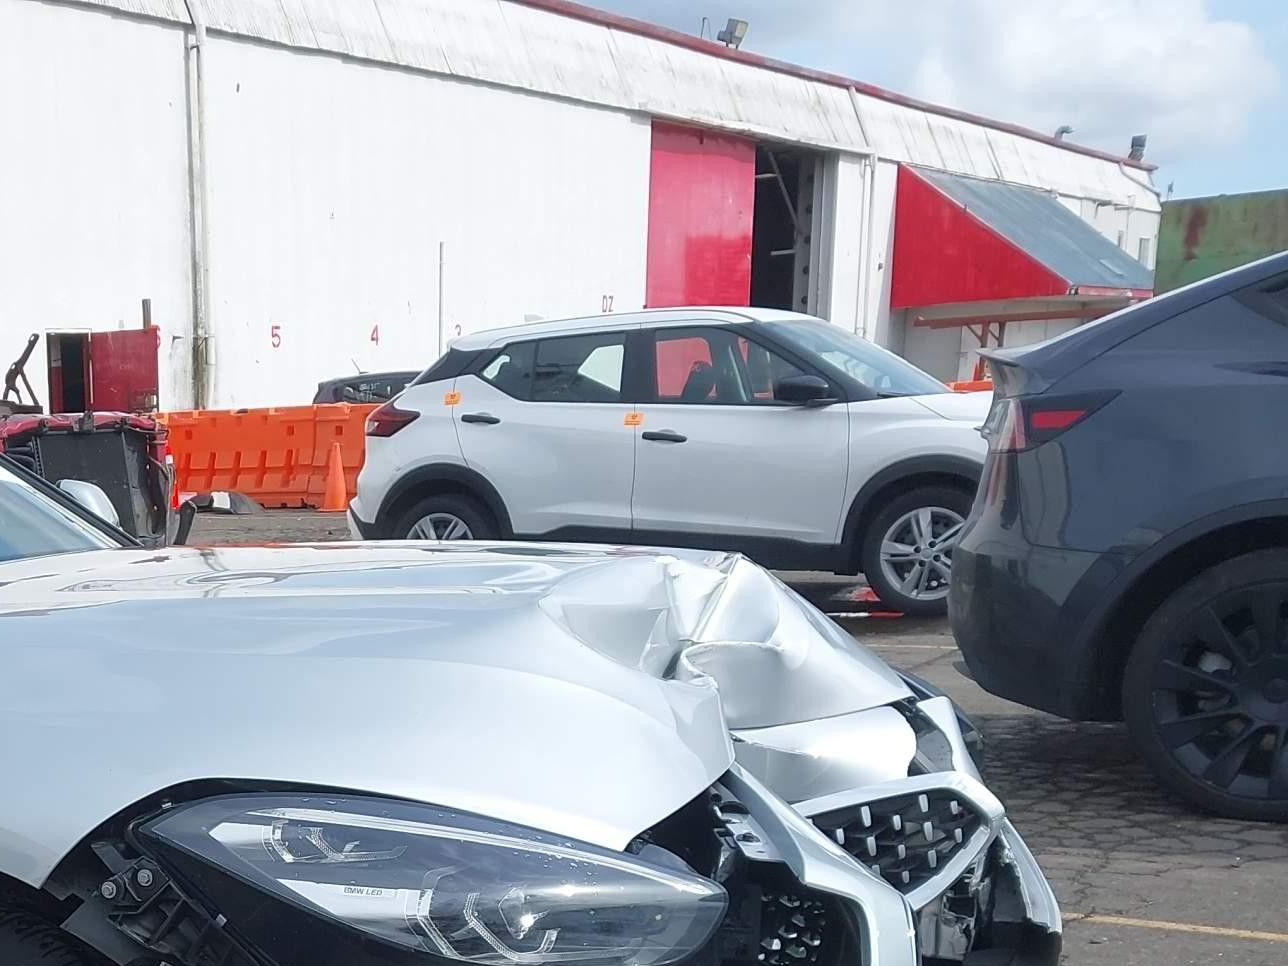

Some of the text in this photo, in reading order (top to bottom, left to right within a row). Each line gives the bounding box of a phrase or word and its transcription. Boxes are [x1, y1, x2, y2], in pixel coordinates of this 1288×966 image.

[271, 325, 281, 348] 5
[370, 324, 380, 346] 4
[343, 886, 365, 895] BMW
